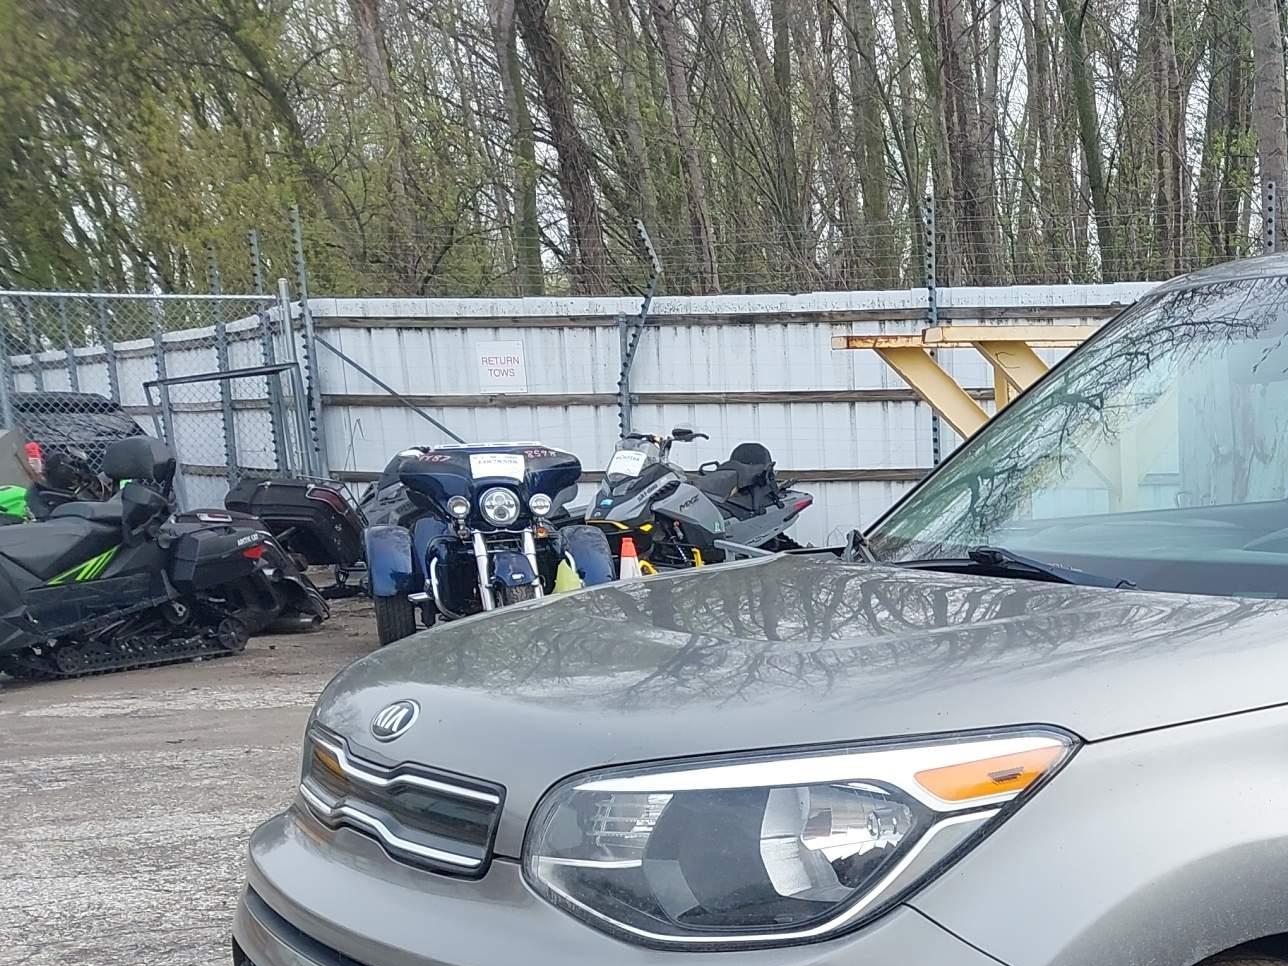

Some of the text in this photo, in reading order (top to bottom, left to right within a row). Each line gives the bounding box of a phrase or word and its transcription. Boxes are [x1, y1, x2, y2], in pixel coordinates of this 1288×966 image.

[481, 356, 520, 366] RETURN
[487, 368, 516, 378] TOWS
[376, 704, 410, 733] KIA
